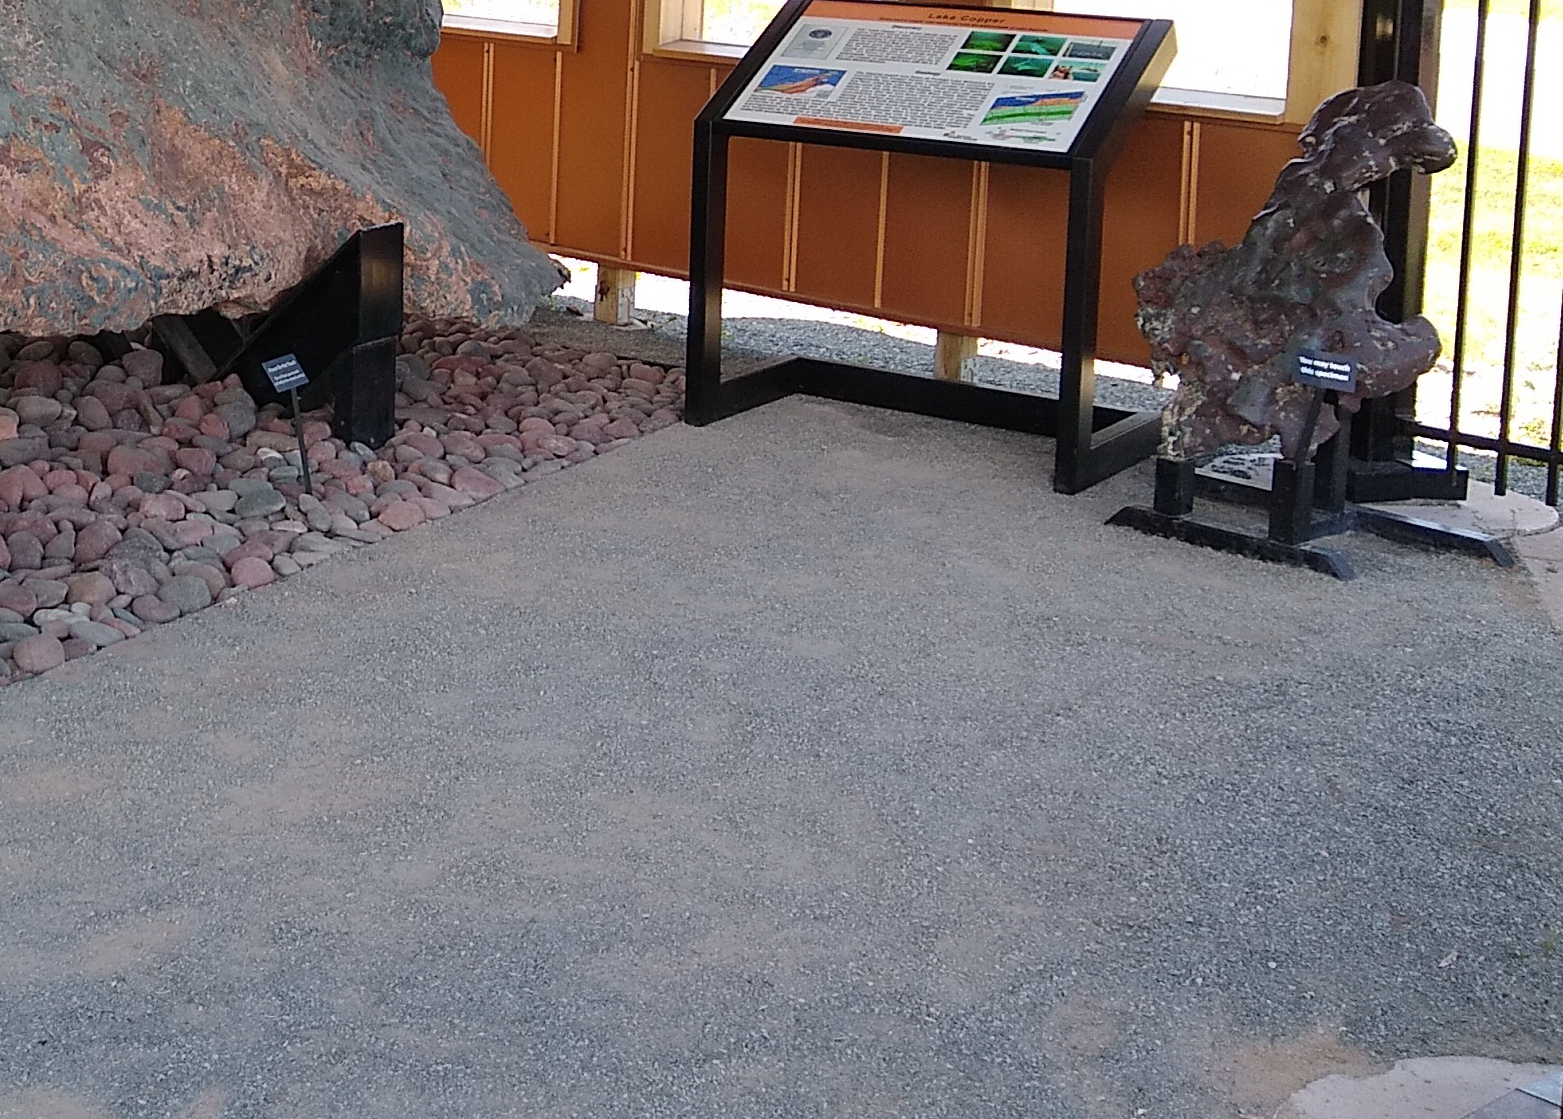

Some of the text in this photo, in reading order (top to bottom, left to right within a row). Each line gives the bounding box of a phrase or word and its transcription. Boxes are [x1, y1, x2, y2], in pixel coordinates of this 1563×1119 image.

[928, 13, 956, 21] Lake
[960, 15, 1005, 25] Copper
[1299, 356, 1351, 372] You may touch
[1300, 366, 1350, 381] this specimen
